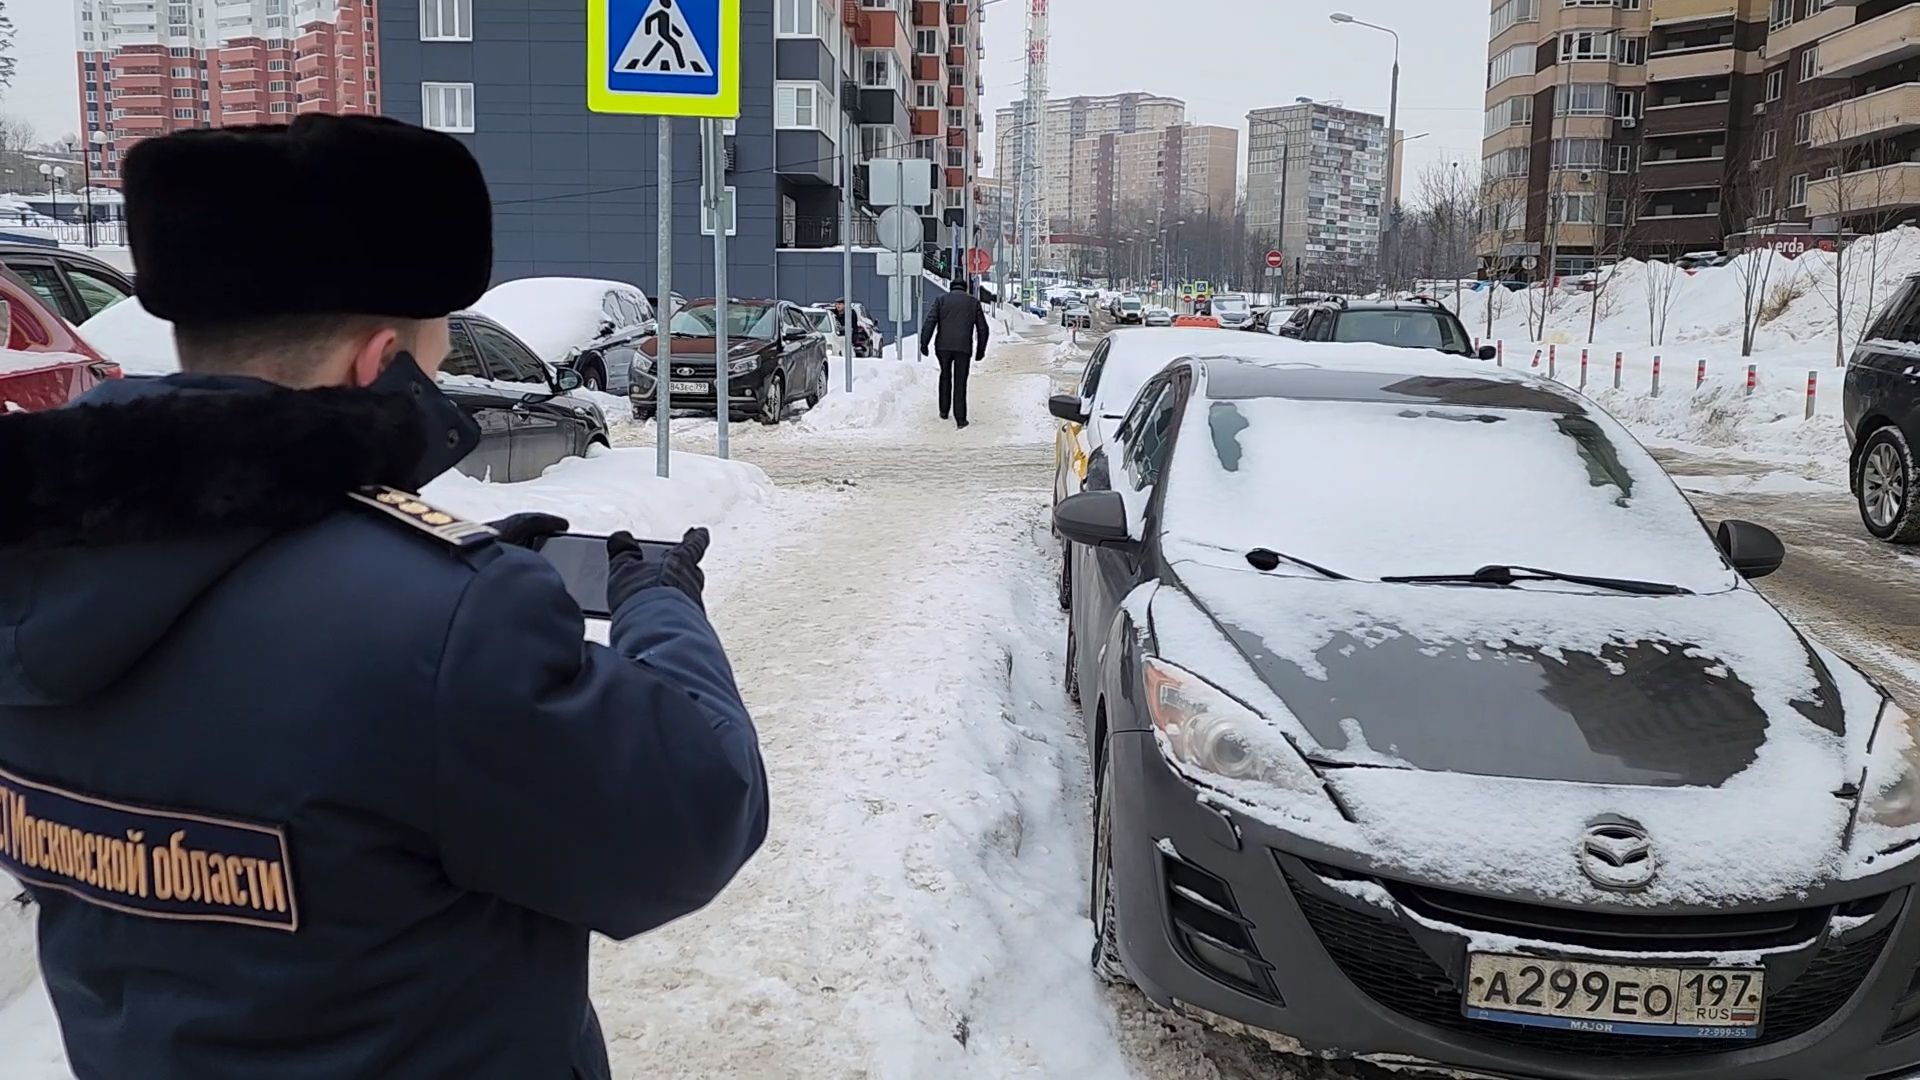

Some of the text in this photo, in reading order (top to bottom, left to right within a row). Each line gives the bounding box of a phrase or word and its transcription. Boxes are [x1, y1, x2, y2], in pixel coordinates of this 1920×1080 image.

[10, 790, 149, 899] Московской
[153, 830, 287, 913] области
[1483, 966, 1752, 1016] А299ЕО 197
[1696, 1008, 1729, 1021] RUS
[1570, 1021, 1614, 1032] MAJOR
[1698, 1028, 1748, 1037] 22-999-55
